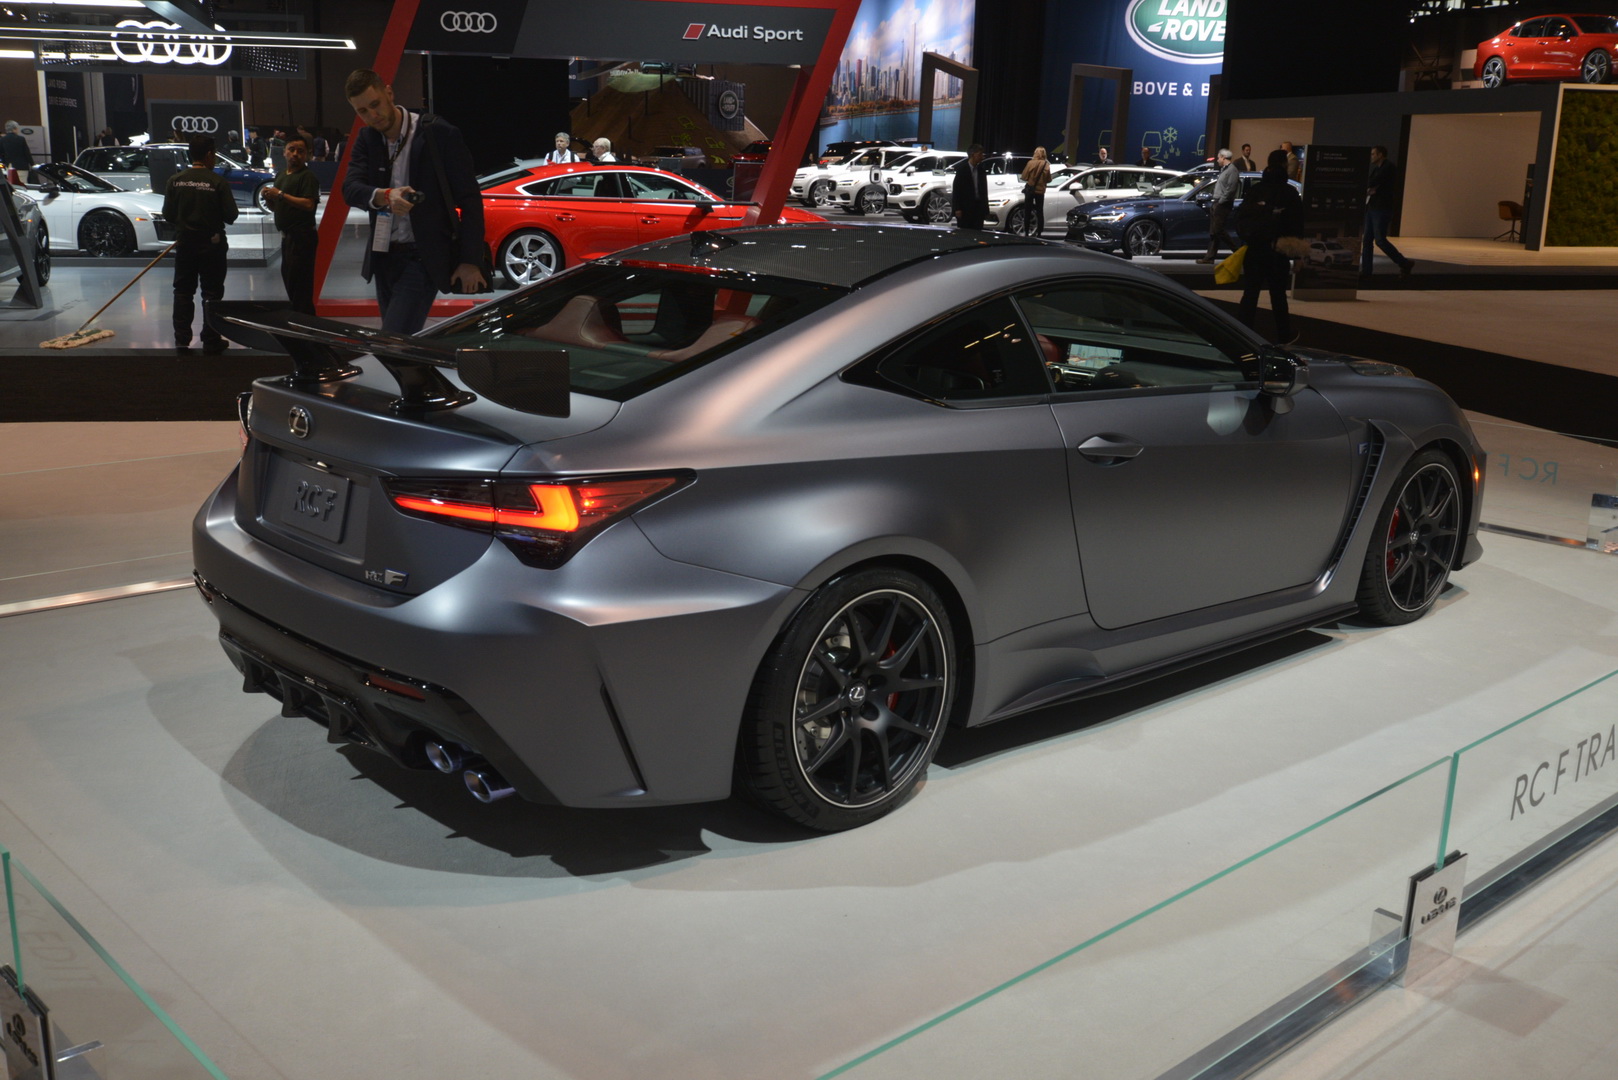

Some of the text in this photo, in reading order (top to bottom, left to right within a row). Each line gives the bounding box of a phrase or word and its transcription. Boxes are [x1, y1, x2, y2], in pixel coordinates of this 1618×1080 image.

[1157, 0, 1226, 18] LAND
[707, 24, 804, 43] Audi Sport
[1161, 18, 1226, 42] ROVE
[1130, 81, 1178, 96] BOVE
[1182, 82, 1193, 97] &
